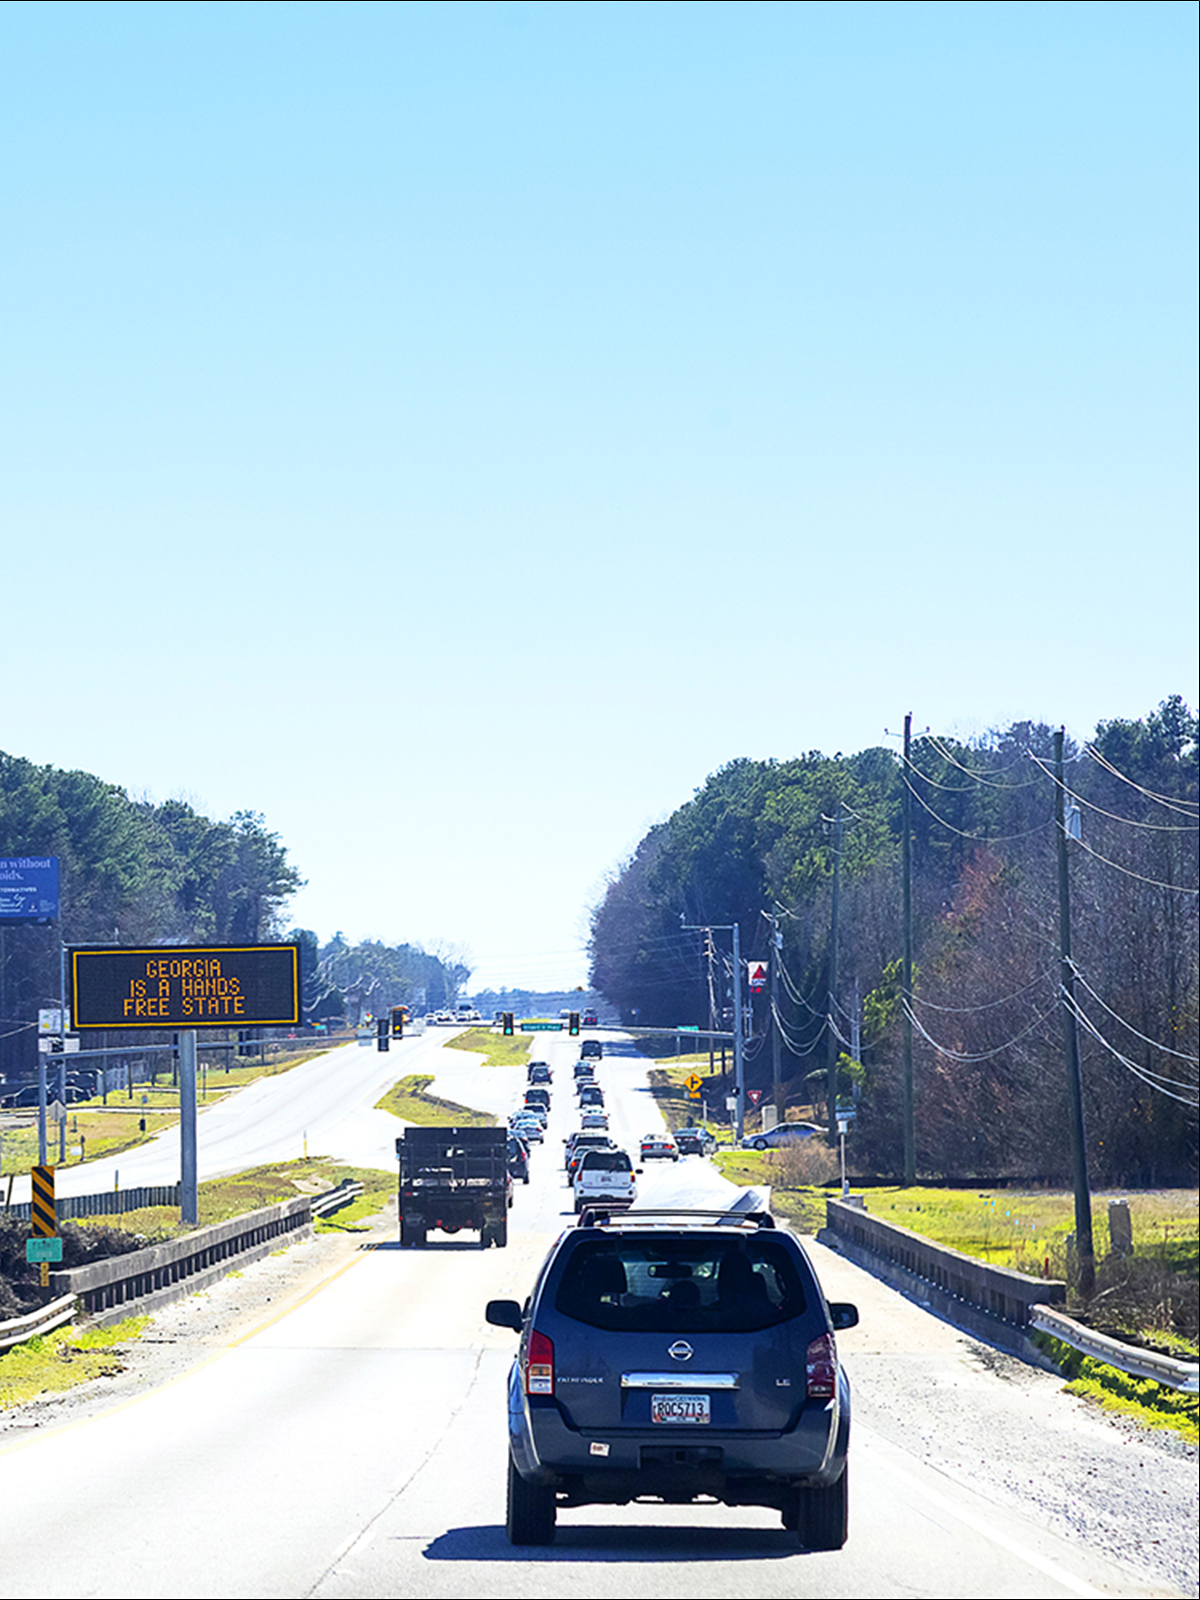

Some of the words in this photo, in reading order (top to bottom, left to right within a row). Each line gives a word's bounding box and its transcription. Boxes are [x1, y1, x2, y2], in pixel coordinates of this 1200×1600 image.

[9, 858, 51, 868] without
[146, 959, 221, 978] GEORGIA
[130, 980, 146, 997] IS
[158, 979, 170, 997] A
[182, 977, 240, 997] HANDS
[123, 998, 170, 1016] FREE
[182, 996, 245, 1015] STATE
